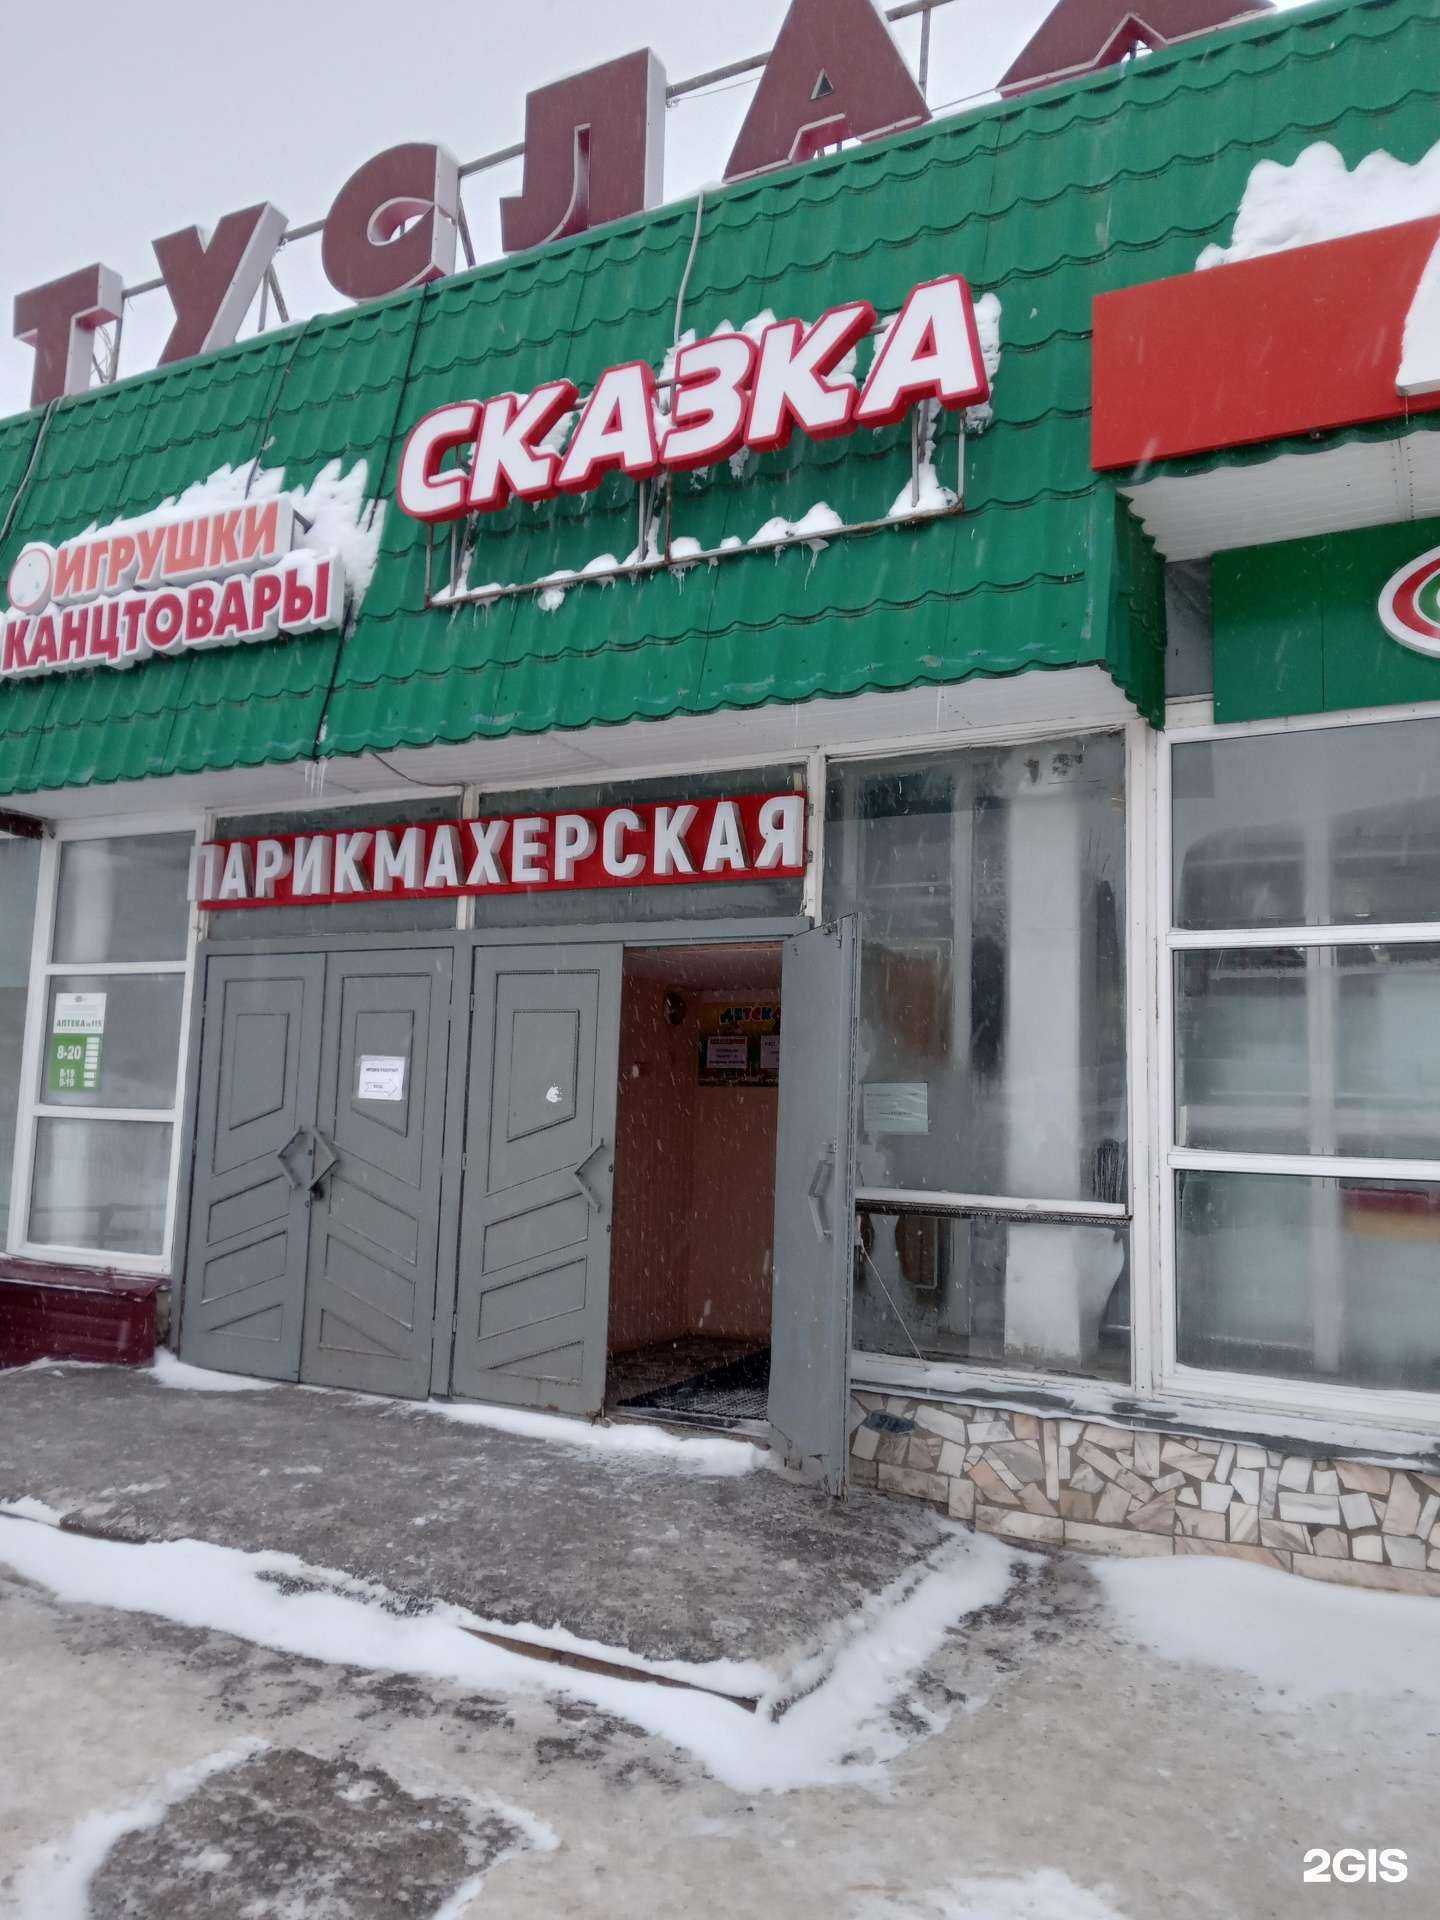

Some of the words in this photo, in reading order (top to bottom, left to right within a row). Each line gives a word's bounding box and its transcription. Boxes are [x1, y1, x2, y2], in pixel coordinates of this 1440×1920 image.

[399, 273, 992, 523] СКАЗКА
[52, 501, 280, 600] ИГРУШКИ
[2, 561, 331, 670] КАНЦТОВАРЫ
[187, 795, 806, 901] ПАРИКМАХЕРСКАЯ
[57, 1019, 85, 1028] АПТЕКА
[57, 1045, 81, 1060] 8-20
